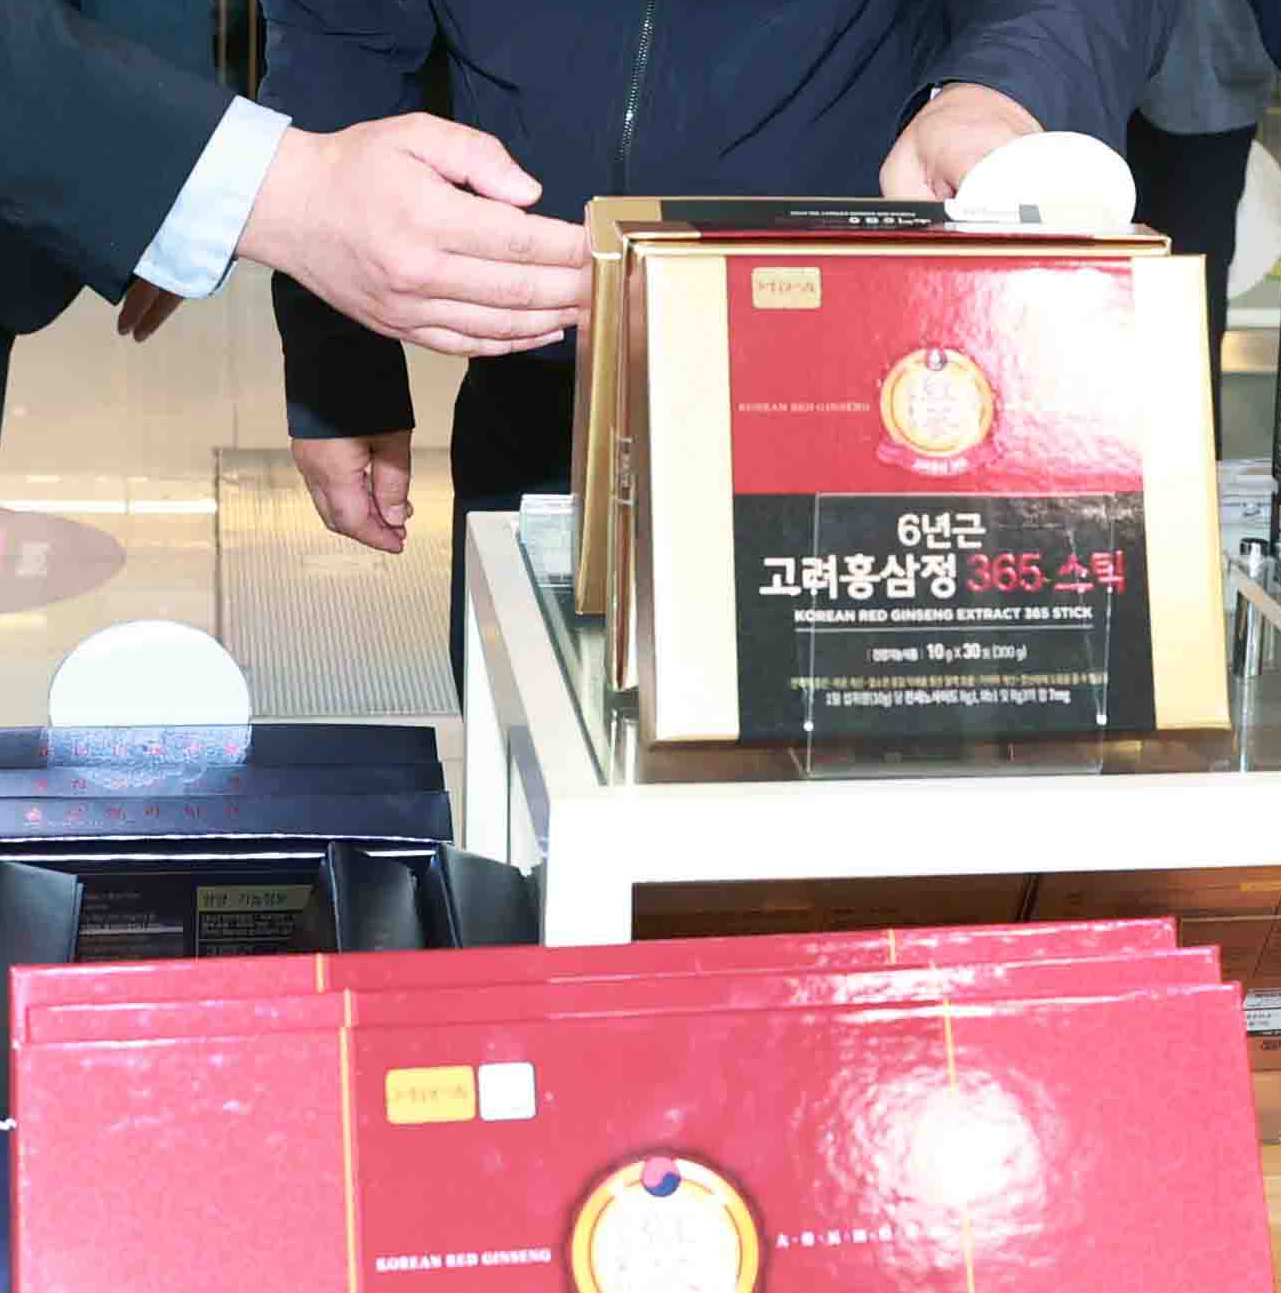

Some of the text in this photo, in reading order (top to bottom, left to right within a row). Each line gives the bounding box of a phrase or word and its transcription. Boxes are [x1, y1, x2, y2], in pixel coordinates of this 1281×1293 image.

[896, 512, 987, 549] 6년근
[759, 549, 1127, 599] 고려홍삼정 365 스틱
[794, 608, 856, 624] KOREAN
[858, 608, 889, 623] RED
[891, 607, 954, 623] GINSENG
[956, 606, 1022, 622] EXTRACT
[1052, 605, 1093, 620] STICK
[375, 1248, 552, 1272] KOREAN RED GINSENG
